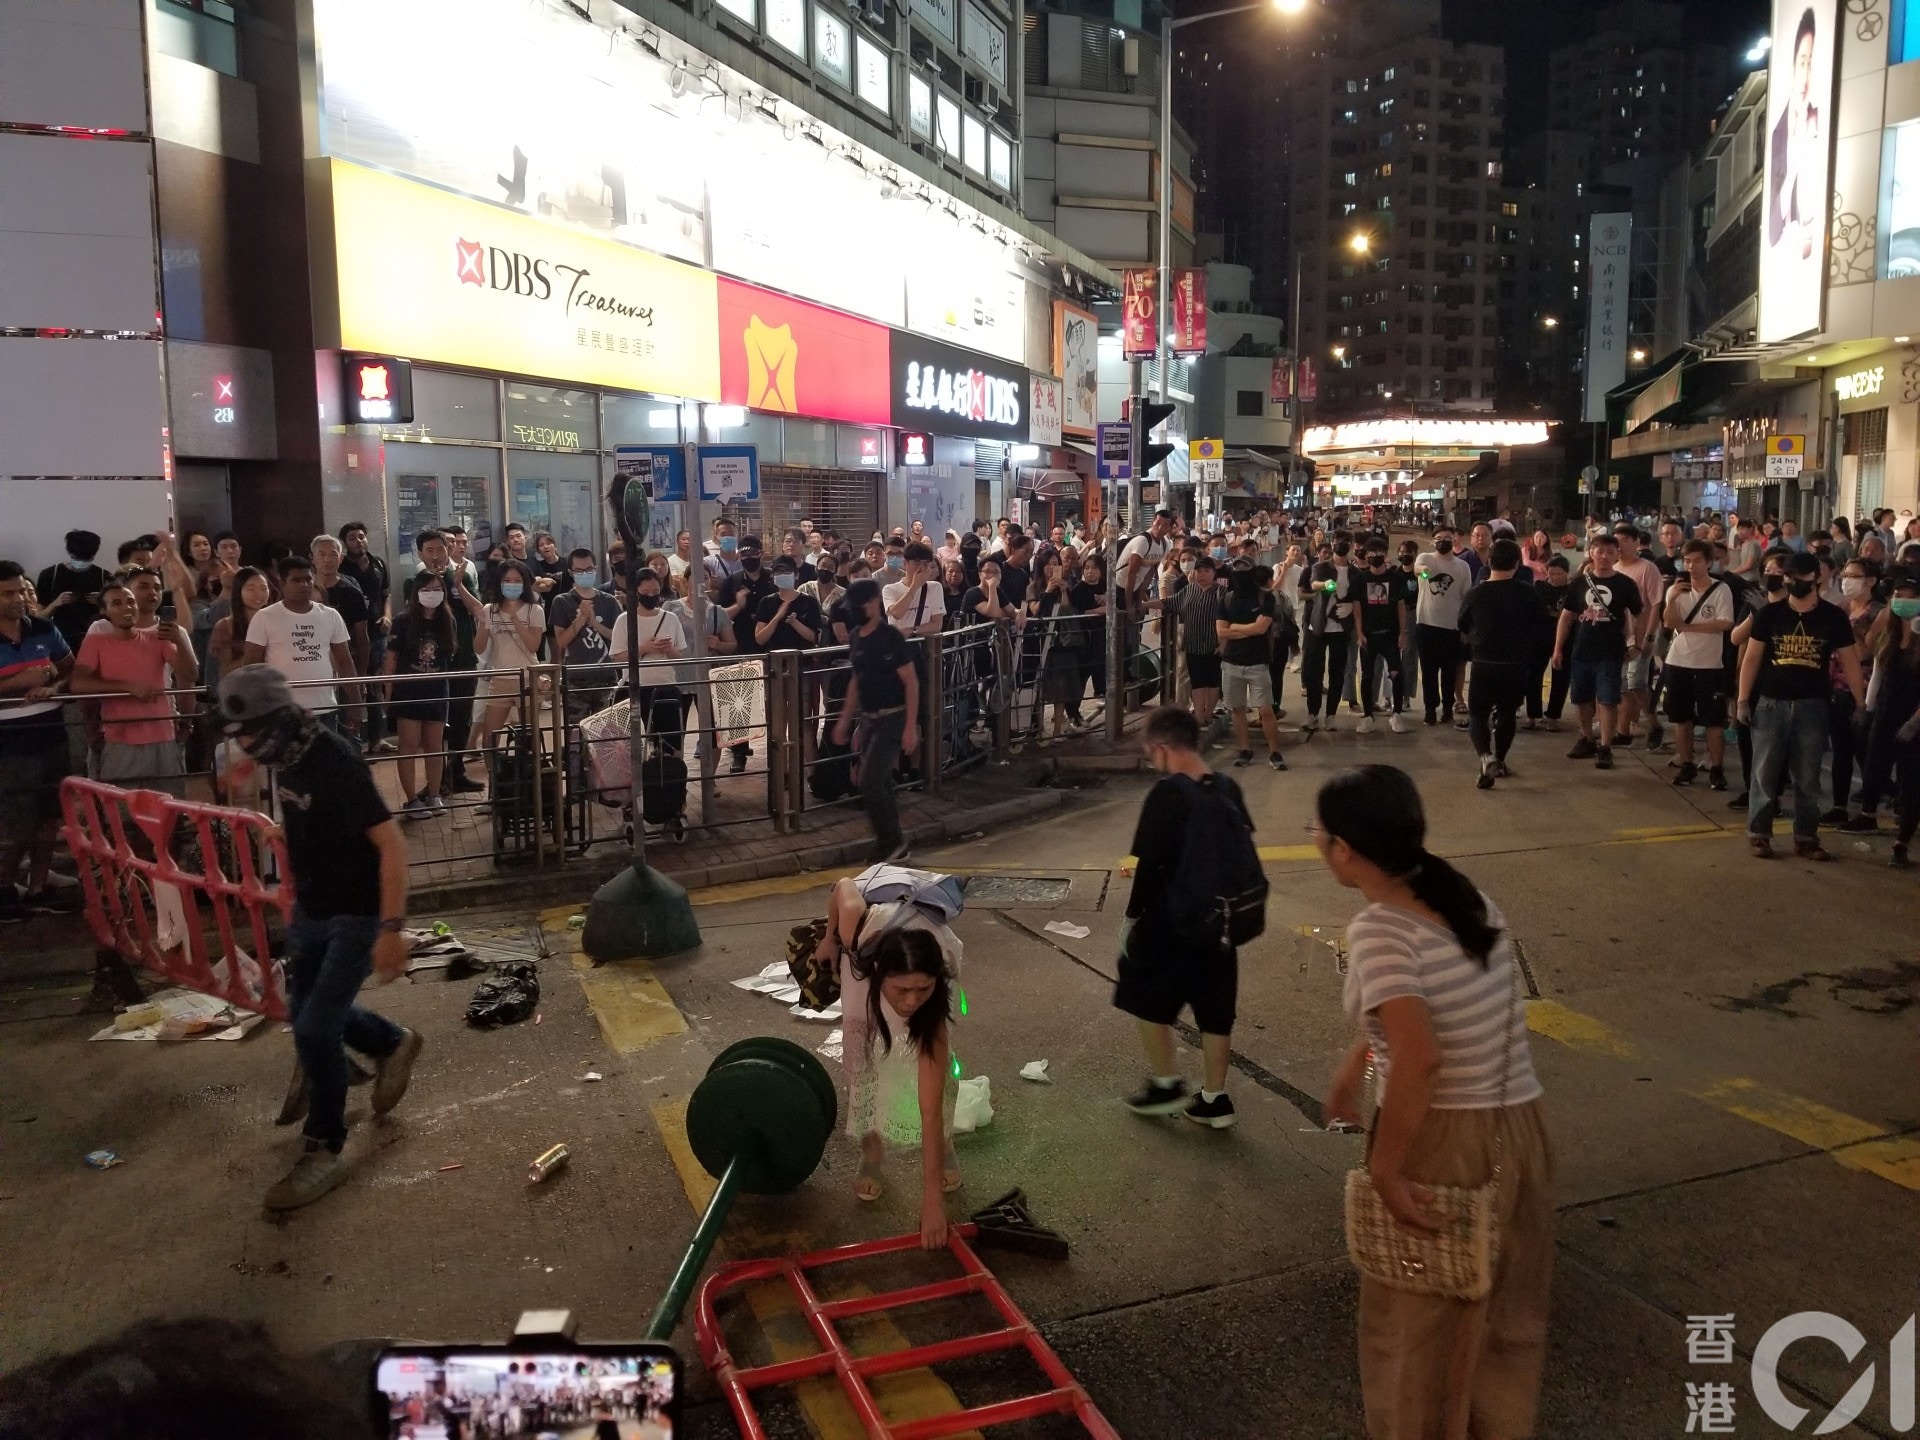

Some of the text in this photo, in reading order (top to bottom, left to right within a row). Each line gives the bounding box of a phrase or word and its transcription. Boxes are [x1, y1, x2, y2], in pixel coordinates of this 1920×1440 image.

[1593, 245, 1627, 257] NCB
[489, 246, 654, 327] DBS Treasures
[1124, 295, 1155, 319] 70
[1602, 262, 1616, 350] 南洋商業銀行
[1206, 461, 1220, 469] hrs
[1773, 466, 1795, 475] 全日
[291, 630, 315, 638] really
[292, 638, 307, 647] not
